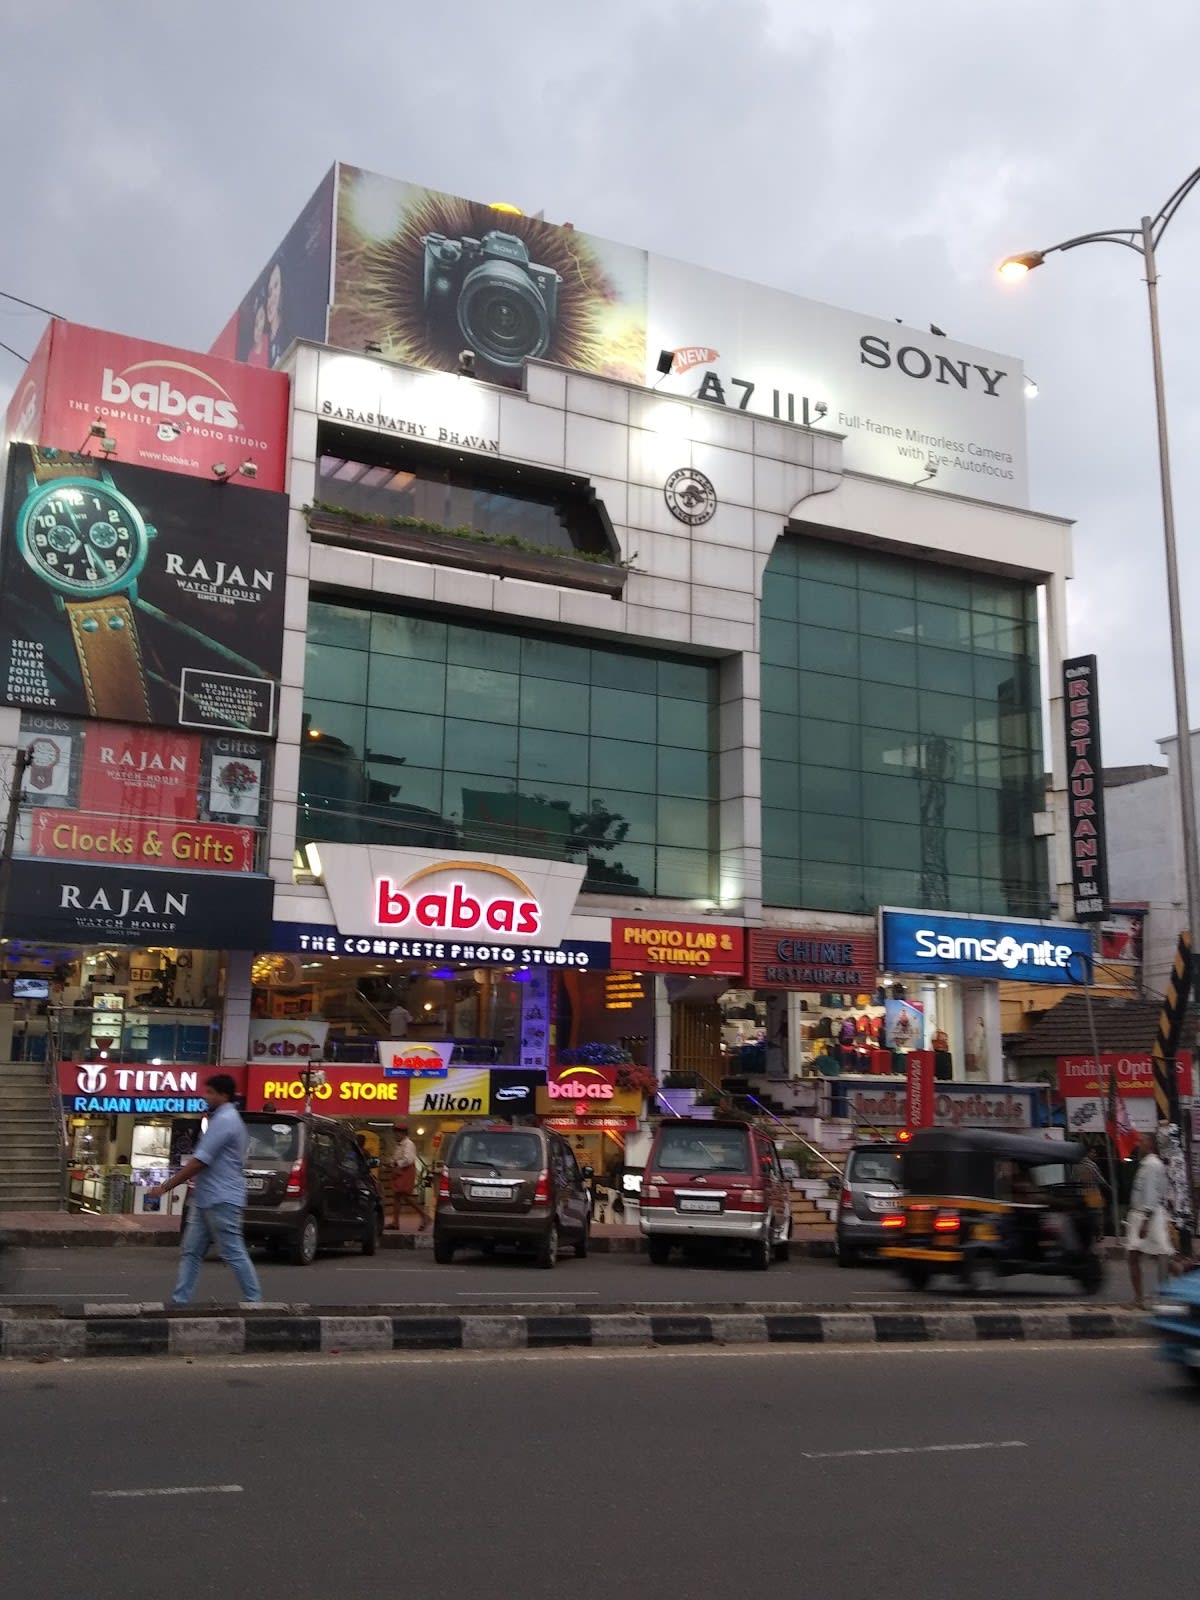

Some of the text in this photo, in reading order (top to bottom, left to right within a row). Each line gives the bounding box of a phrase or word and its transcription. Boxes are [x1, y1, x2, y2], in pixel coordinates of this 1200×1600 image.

[677, 349, 709, 367] NEW
[860, 335, 1007, 396] SONY
[101, 368, 239, 428] babas
[69, 400, 268, 450] THE COMPLETE PHOTO STUDIO
[838, 412, 1013, 463] Full-frame Mirrorless Camera
[139, 449, 200, 468] www.babas.in
[897, 444, 1015, 480] with Eye-Autofocus
[93, 498, 101, 511] 1
[37, 515, 56, 528] 10
[108, 509, 120, 523] 2
[35, 534, 48, 547] 9
[118, 527, 129, 540] 3
[46, 552, 58, 565] 8
[64, 563, 75, 577] 7
[165, 552, 275, 592] RAJAN
[176, 579, 261, 601] WATCH HOUSE
[12, 639, 44, 651] SEIKO
[12, 648, 44, 660] TITAN
[9, 666, 46, 679] FOSSIL
[10, 657, 44, 670] TIMEX
[7, 684, 50, 697] EDIFICE
[8, 675, 48, 688] POLICE
[100, 747, 187, 772] RAJAN
[106, 770, 179, 785] WATCH HOUSE
[1067, 678, 1098, 878] RESTAURANT
[52, 823, 234, 863] Clocks & Gifts
[58, 884, 189, 918] RAJAN
[376, 879, 541, 934] babas
[75, 917, 176, 931] WATCH HOUSE
[624, 927, 733, 950] PHOTO LAB &
[299, 934, 590, 966] THE COMPLETE PHOTO STUDIO
[647, 947, 711, 967] STUDIO
[777, 939, 854, 965] CHIME
[767, 967, 864, 985] RESTAURANT
[253, 1039, 320, 1057] baba
[392, 1054, 444, 1069] babas
[114, 1069, 198, 1092] TITAN
[548, 1080, 615, 1098] babas
[264, 1081, 398, 1100] PHOO STORE
[74, 1097, 131, 1113] RAJAN
[135, 1098, 185, 1113] WATCH
[423, 1093, 482, 1112] Nikon
[935, 1093, 1023, 1124] Opticals
